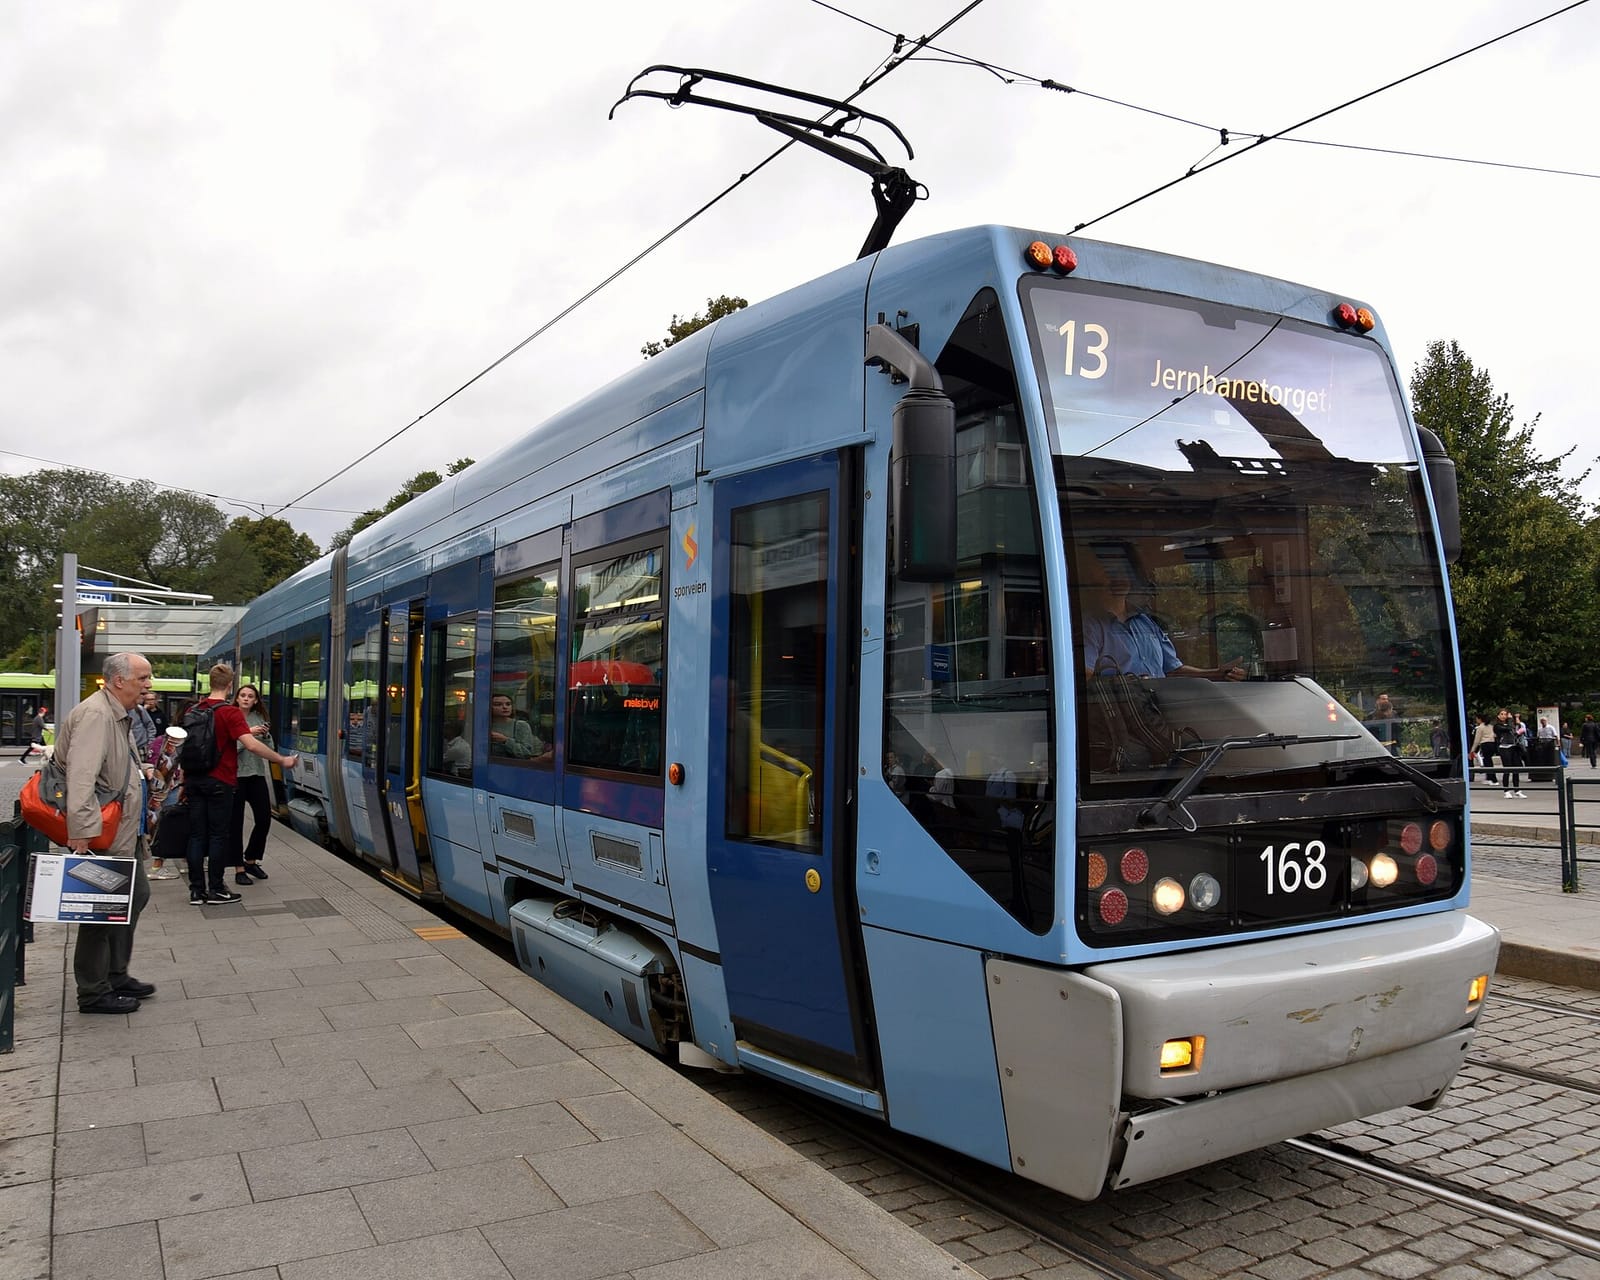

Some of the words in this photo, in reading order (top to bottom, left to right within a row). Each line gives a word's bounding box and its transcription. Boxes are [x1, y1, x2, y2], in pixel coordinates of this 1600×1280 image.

[1060, 320, 1109, 379] 13
[1151, 359, 1327, 416] Jernbanetorget
[674, 580, 706, 600] sporveien
[1260, 840, 1327, 895] 168
